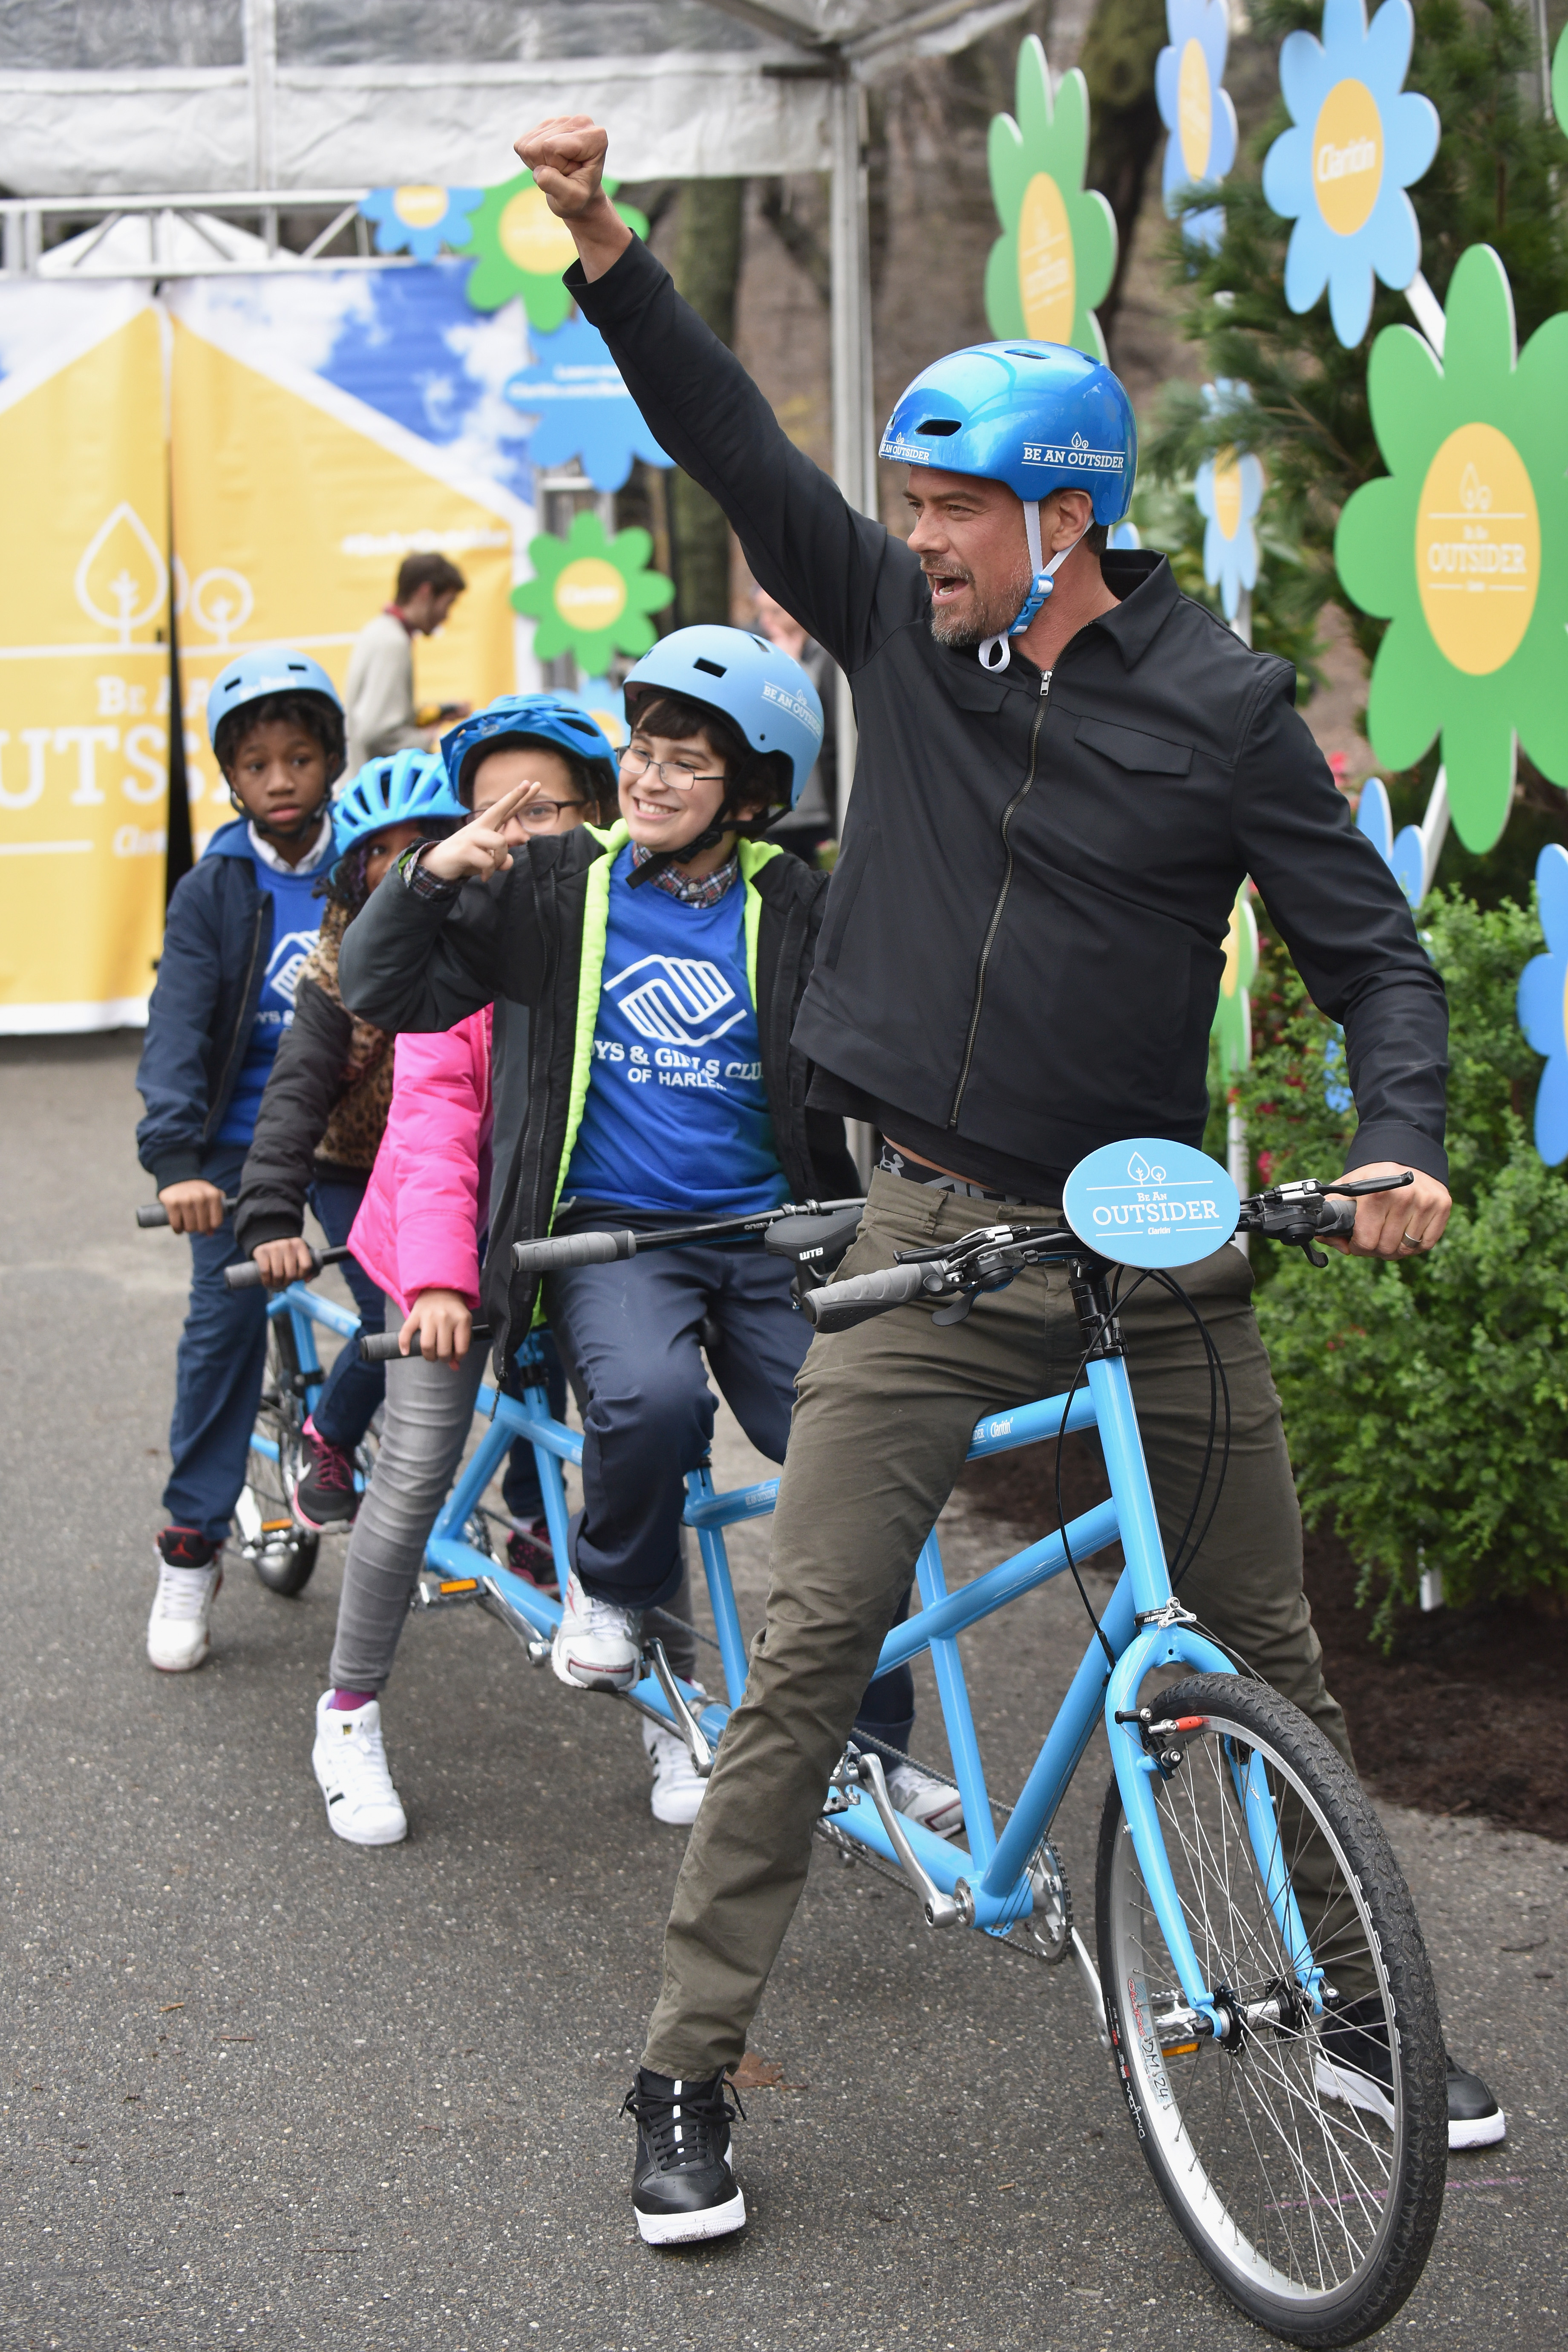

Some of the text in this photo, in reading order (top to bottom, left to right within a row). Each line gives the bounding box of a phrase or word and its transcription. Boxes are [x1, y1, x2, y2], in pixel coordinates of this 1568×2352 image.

[885, 444, 893, 453] AN
[893, 446, 929, 461] OUTSIDER
[1023, 447, 1124, 468] BE AN OUTSIDER
[1428, 543, 1527, 574] OUTSIDER
[763, 685, 778, 700] BE
[778, 693, 793, 709] AN
[591, 1041, 625, 1062] YS
[630, 1046, 650, 1065] &
[725, 1061, 764, 1081] CLU
[628, 1068, 652, 1083] OF
[1092, 1200, 1219, 1226] OUTSIDER
[799, 1247, 824, 1260] WTB
[1127, 2081, 1146, 2139] Drifter
